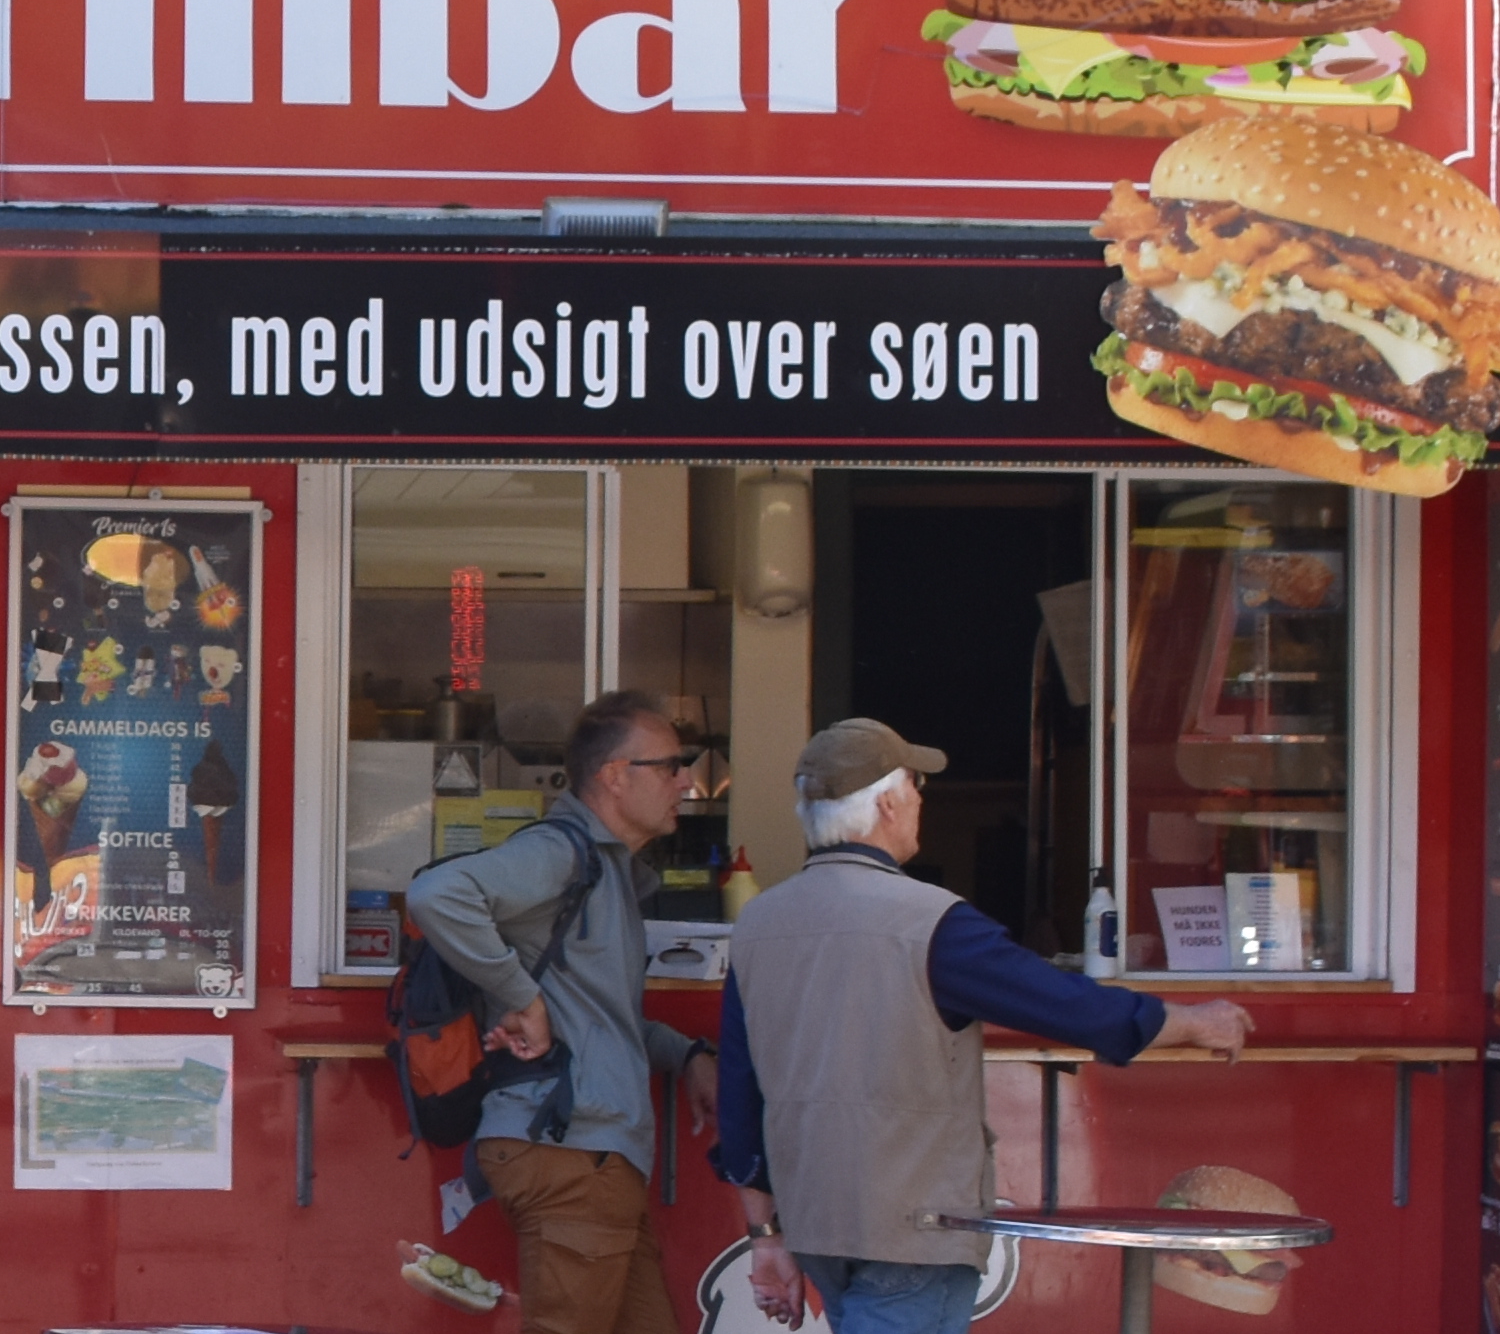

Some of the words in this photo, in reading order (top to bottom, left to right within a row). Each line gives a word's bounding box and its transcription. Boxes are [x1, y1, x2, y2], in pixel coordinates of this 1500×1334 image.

[229, 298, 384, 400] med
[418, 301, 651, 409] udsigt
[683, 315, 837, 403] over
[868, 317, 1041, 405] søen
[92, 517, 159, 537] Premier
[50, 719, 189, 738] GAMMELDAGS
[194, 721, 212, 738] IS
[97, 831, 174, 849] SOFTICE
